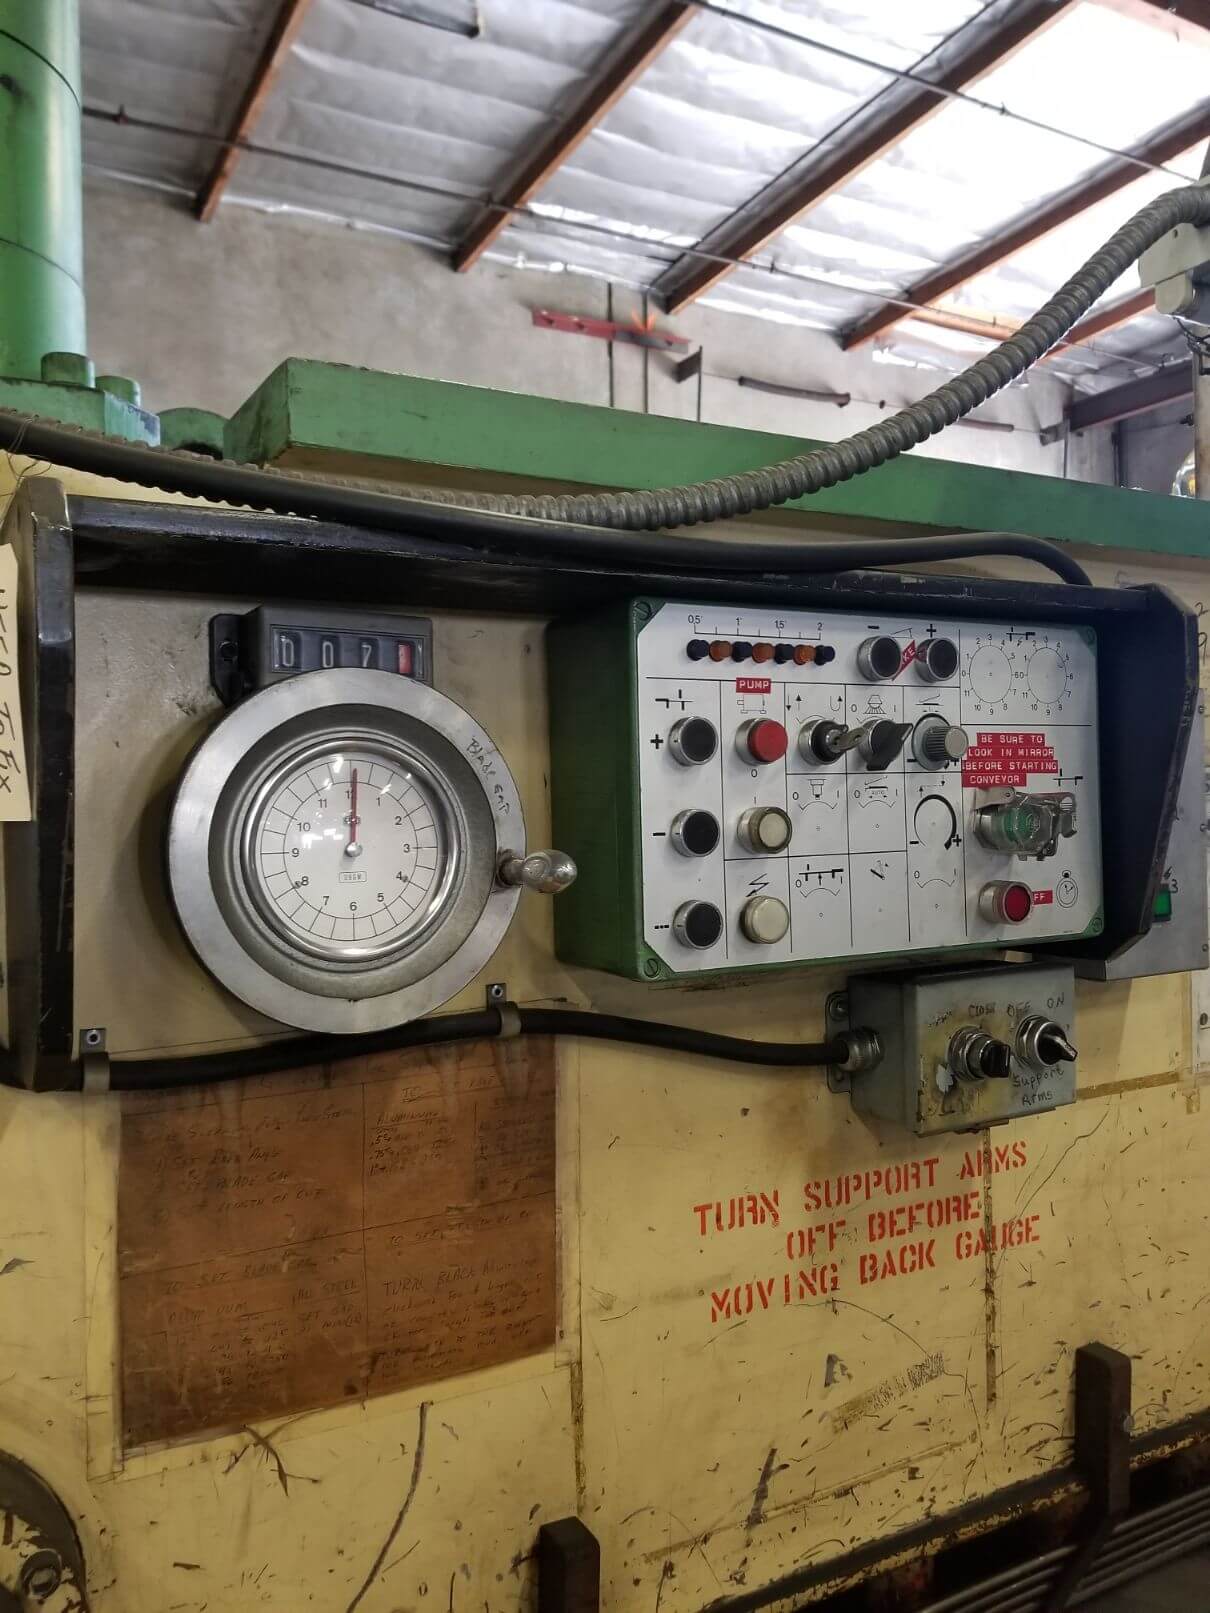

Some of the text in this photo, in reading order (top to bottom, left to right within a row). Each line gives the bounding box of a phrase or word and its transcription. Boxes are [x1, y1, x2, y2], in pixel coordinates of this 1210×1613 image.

[739, 680, 769, 688] PUMP
[981, 734, 1043, 744] BE SURE TO
[968, 748, 1054, 757] LOOK IN MIRROR
[965, 761, 1057, 770] BEFORE STARTING
[969, 775, 1020, 784] CONVEYOR
[317, 799, 328, 809] 11
[394, 816, 402, 825] 2
[297, 822, 311, 832] 10
[291, 848, 300, 857] 9
[403, 844, 411, 853] 3
[395, 871, 403, 880] 4
[301, 876, 309, 886] 8
[322, 896, 330, 906] 7
[377, 893, 384, 901] 5
[349, 902, 357, 911] 6
[1046, 992, 1065, 1009] ON
[694, 1140, 1027, 1236] TURN SUPPORT ARMS
[786, 1190, 981, 1260] OFF BEFORE
[711, 1214, 1041, 1323] MOVING BACK GAUGE
